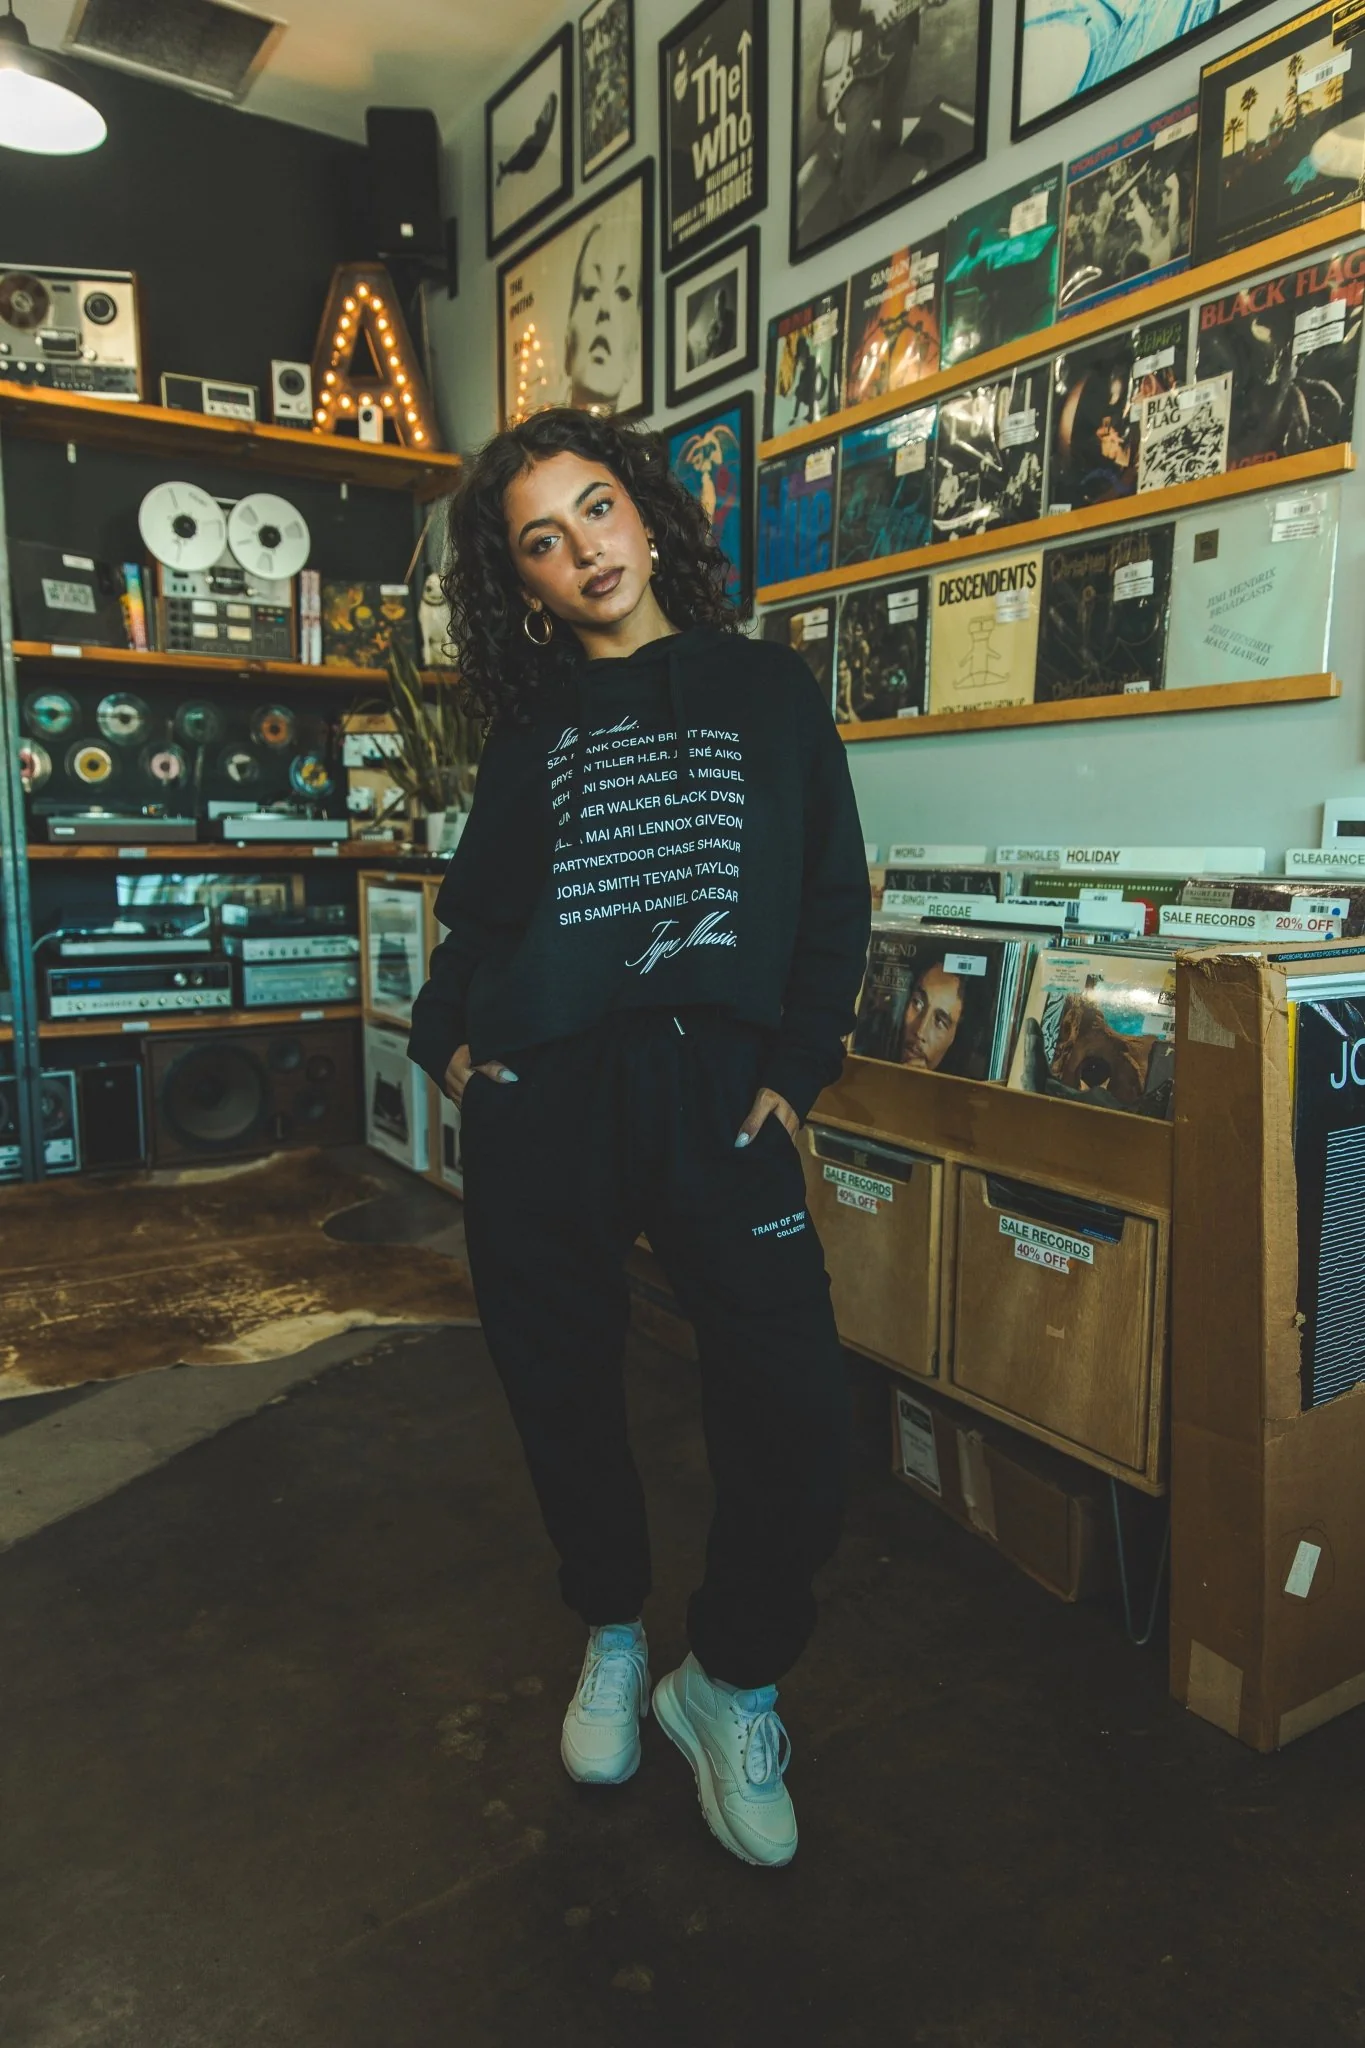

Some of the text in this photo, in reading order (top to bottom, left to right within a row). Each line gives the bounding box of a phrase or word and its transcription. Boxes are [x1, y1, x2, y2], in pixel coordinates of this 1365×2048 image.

[691, 54, 741, 124] The
[1201, 278, 1288, 331] BLACK
[1295, 250, 1365, 298] FLAG
[1147, 393, 1182, 416] BLAC
[938, 561, 1037, 607] DESCENDENTS
[1229, 567, 1277, 597] HENDRIX
[547, 755, 568, 770] SZA
[612, 734, 654, 749] OCEAN
[658, 729, 698, 742] BRT
[701, 729, 739, 742] FAIYAZ
[551, 746, 742, 789] BRYSN TILLER H.E.R. JENÉ AIKO
[552, 768, 744, 810] KEHNI SNOH AALEGA MIGUEL
[607, 795, 661, 814] WALKER
[664, 790, 707, 806] 6LACK
[710, 790, 745, 805] DVSN
[586, 828, 610, 844] MAI
[613, 825, 635, 840] ARI
[638, 816, 693, 836] LENNOX
[695, 813, 743, 830] GIVEON
[553, 838, 741, 874] PARTYNEXTDOOR CHASE SHAKUR
[1016, 849, 1060, 861] SINGLES
[1067, 849, 1121, 863] HOLIDAY
[1292, 853, 1365, 865] CLEARANCE
[556, 861, 740, 900] JORJA SMITH TEYANA TAYLOR
[559, 887, 739, 926] SIR SAMPHA DANIEL CAESAR
[928, 904, 972, 918] REGGAE
[1163, 911, 1334, 932] SALE RECORDS 20% OFF
[625, 919, 681, 975] Type
[825, 1167, 891, 1197] SALE RECORDS
[858, 1196, 876, 1209] OFF
[752, 1221, 778, 1236] TRAIN
[780, 1216, 791, 1227] OF
[1001, 1218, 1029, 1238] SALE
[1032, 1228, 1090, 1258] RECORDS
[1017, 1243, 1067, 1268] 40% OFF
